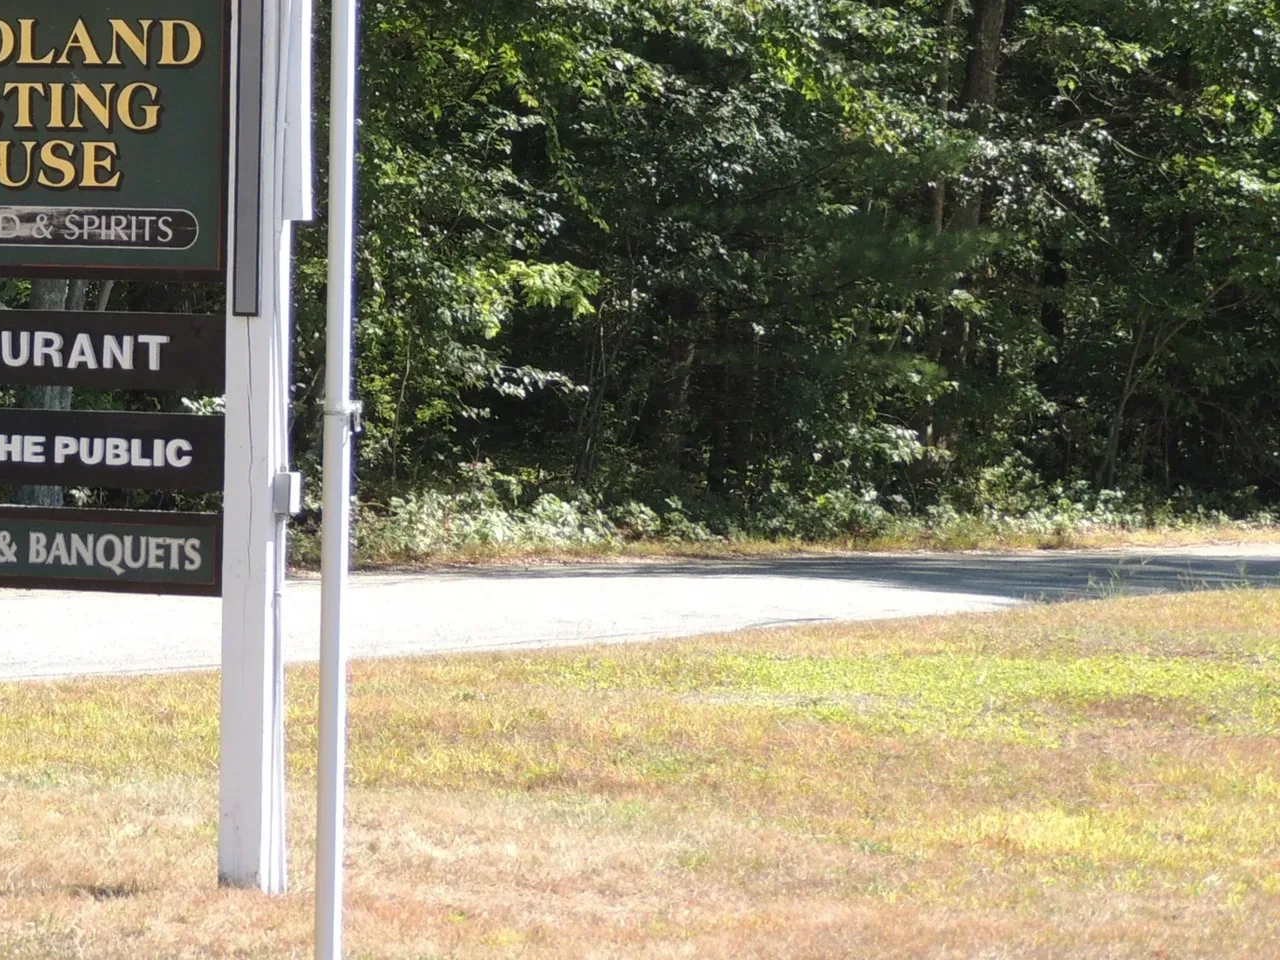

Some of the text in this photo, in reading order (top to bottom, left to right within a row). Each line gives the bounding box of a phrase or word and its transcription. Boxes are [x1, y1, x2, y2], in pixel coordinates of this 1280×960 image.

[31, 213, 54, 239] &
[64, 212, 174, 242] SPIRITS
[53, 436, 193, 468] PUBLIC
[28, 531, 202, 576] BANQUETS
